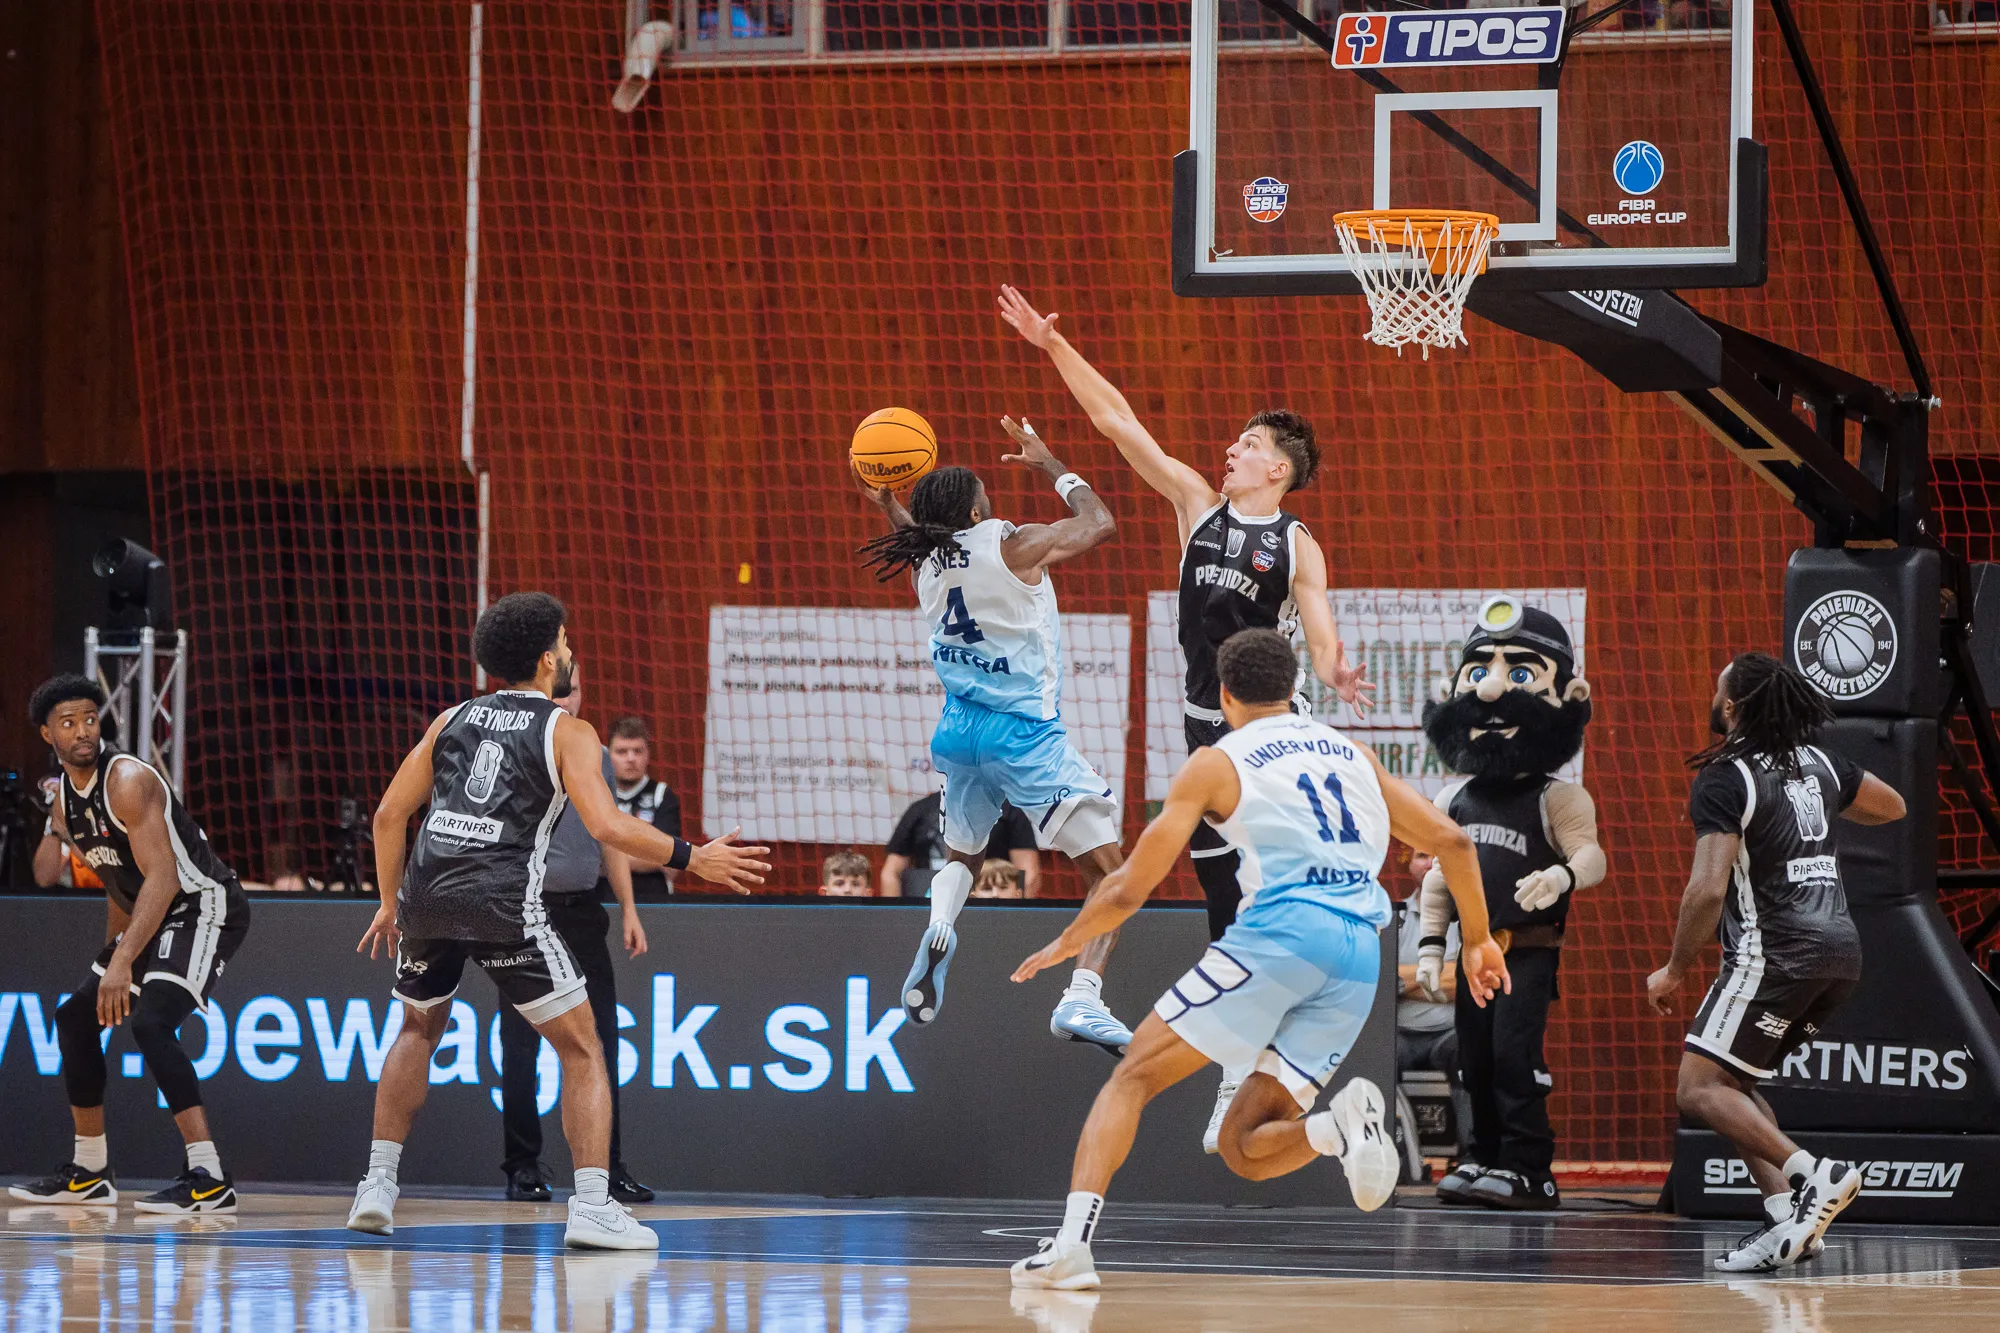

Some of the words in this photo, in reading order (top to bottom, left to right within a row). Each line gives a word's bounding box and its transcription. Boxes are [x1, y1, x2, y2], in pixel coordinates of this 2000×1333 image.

[1398, 17, 1551, 58] TIPOS
[1249, 196, 1283, 211] SBL
[1256, 186, 1286, 194] TIPOS
[1587, 213, 1652, 225] EUROPE
[1655, 212, 1687, 224] CUP
[1619, 199, 1656, 211] FIBA
[858, 461, 915, 476] Wilson
[941, 586, 985, 645] 4
[1809, 596, 1883, 627] PRIEVIDZA
[1800, 641, 1813, 651] EST.
[1877, 641, 1892, 650] 1947
[933, 646, 1012, 676] NITRA
[1805, 661, 1887, 694] BASKETBALL
[464, 705, 536, 732] REYNOLDS
[464, 739, 505, 805] 9
[84, 807, 99, 837] 1
[1296, 772, 1361, 844] 11
[1783, 775, 1829, 842] 15
[432, 816, 496, 836] PARTNERS
[159, 930, 174, 959] 1
[1776, 1041, 1968, 1091] RTNERS
